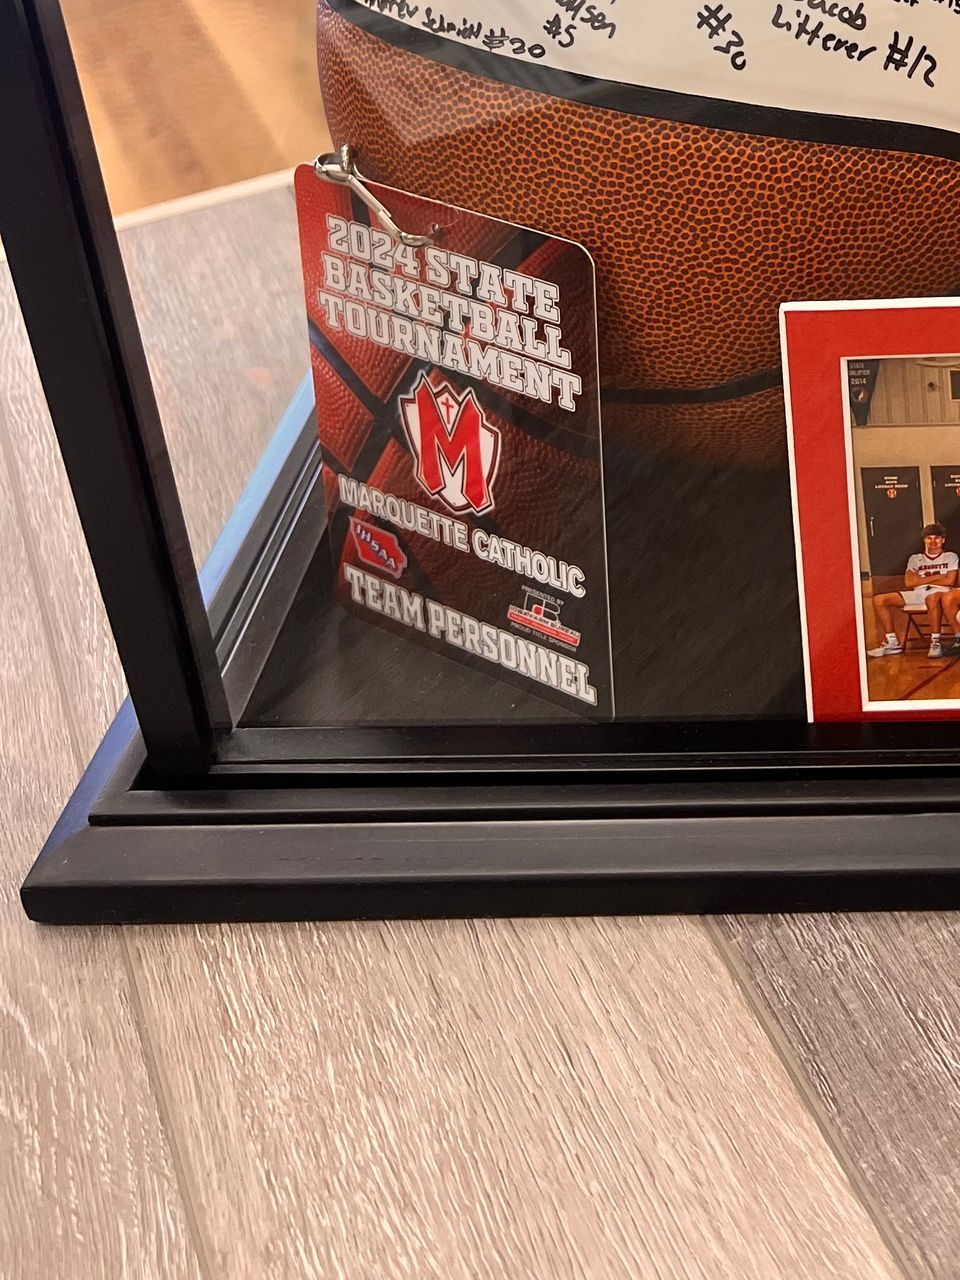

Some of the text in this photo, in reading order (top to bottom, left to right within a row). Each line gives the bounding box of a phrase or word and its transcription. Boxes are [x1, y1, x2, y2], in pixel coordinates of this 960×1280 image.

[883, 32, 939, 88] #12
[321, 251, 573, 370] BASKETBALL
[326, 213, 561, 324] 2024 STATE
[318, 288, 582, 413] TOURNAMENT
[338, 474, 587, 598] MARQUETTE CATHOLIC
[356, 523, 397, 570] IHSAA
[344, 563, 598, 707] TEAM PERSONNEL
